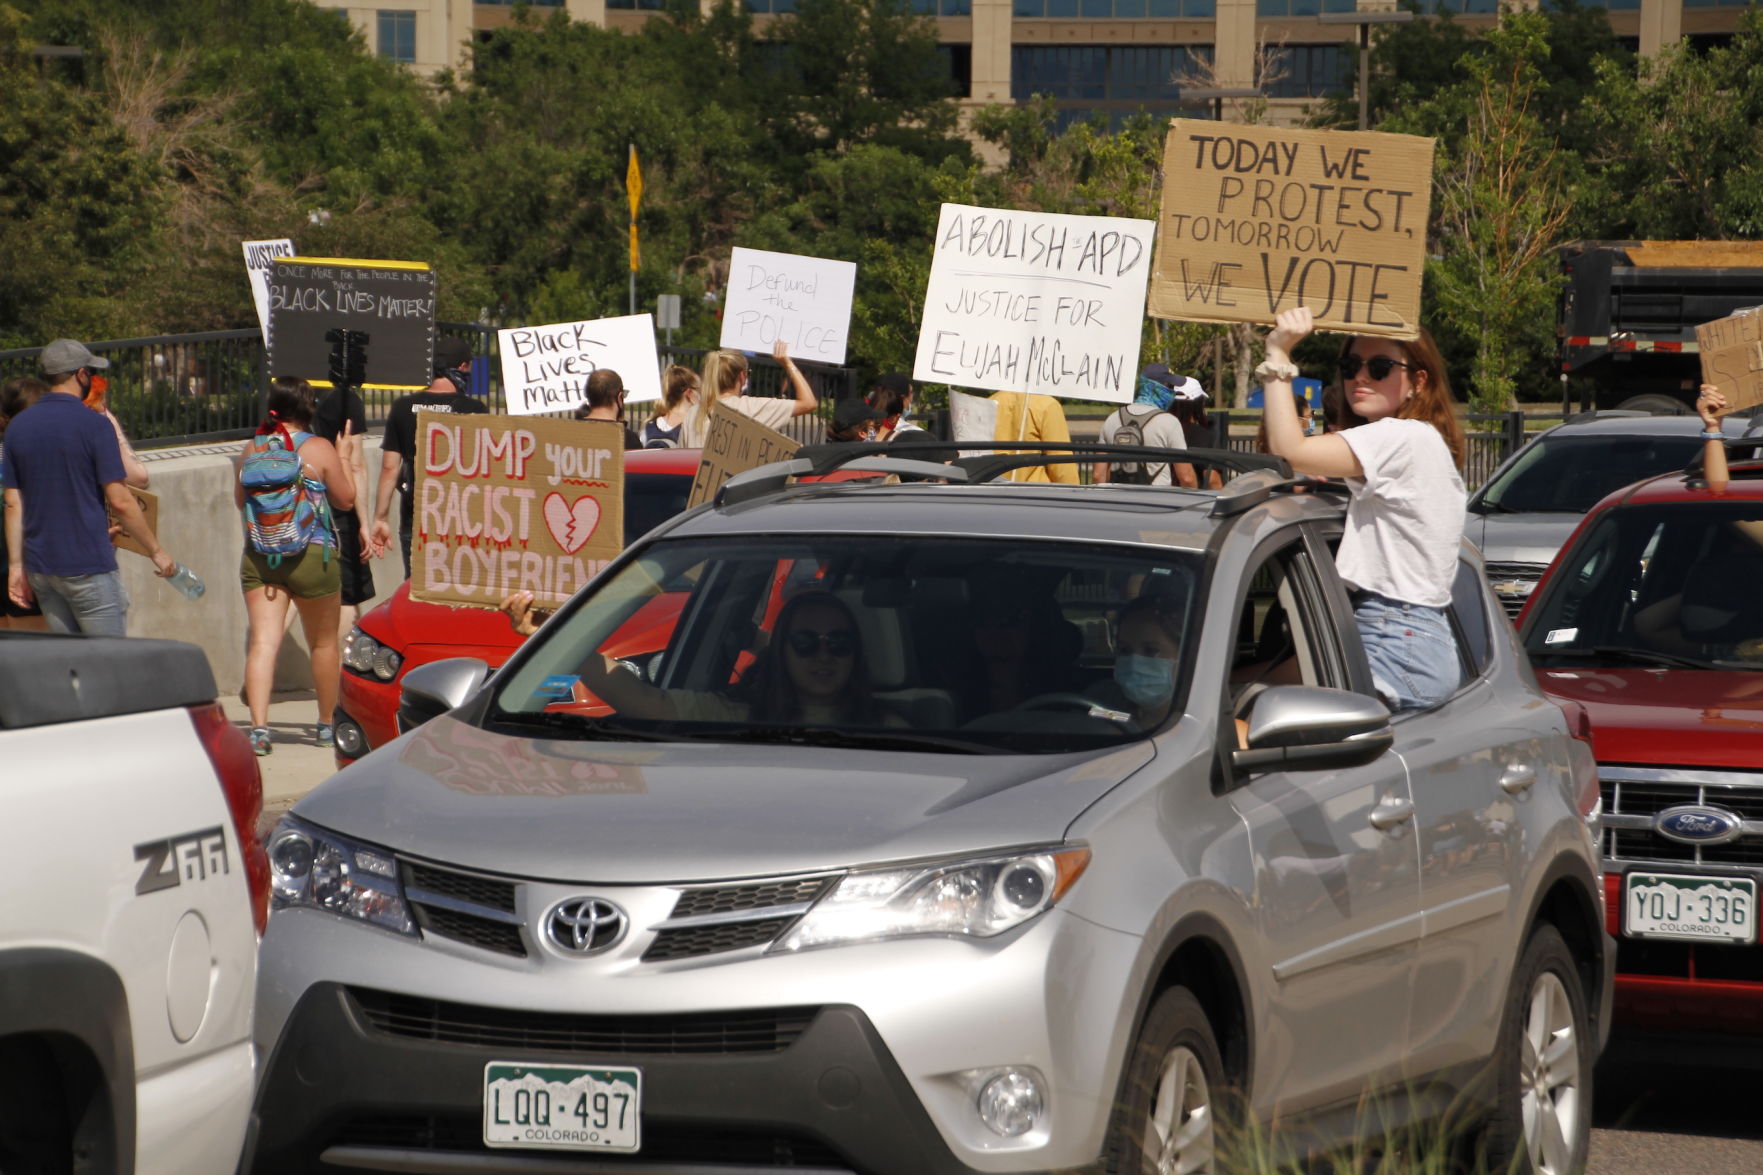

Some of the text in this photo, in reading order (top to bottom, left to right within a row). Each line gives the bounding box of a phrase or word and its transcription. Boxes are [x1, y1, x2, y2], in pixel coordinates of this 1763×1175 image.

[1189, 134, 1371, 181] TODAY WE
[1217, 176, 1414, 239] PROTEST,
[941, 214, 1068, 271] ABOLISH
[1077, 230, 1143, 277] APD
[1171, 213, 1344, 253] TOMORROW
[277, 265, 429, 283] ONCE MORE FOR THE PEOPLE IN THE
[747, 264, 818, 301] Defund
[1181, 252, 1408, 328] WE VOTE
[270, 285, 331, 311] BLACK
[336, 290, 375, 313] LIVES
[378, 295, 432, 319] MATTER!
[762, 293, 799, 312] the
[945, 288, 1107, 327] JUSTICE FOR
[511, 323, 607, 358] Black
[736, 310, 838, 354] POLICE
[523, 353, 596, 383] Lives
[425, 421, 612, 486] DUMP your
[707, 414, 738, 458] REST
[737, 435, 751, 462] IN
[421, 478, 536, 544] RACIST
[1675, 814, 1716, 832] Ford
[1659, 922, 1721, 934] COLORADO
[525, 1128, 599, 1142] COLORADO
